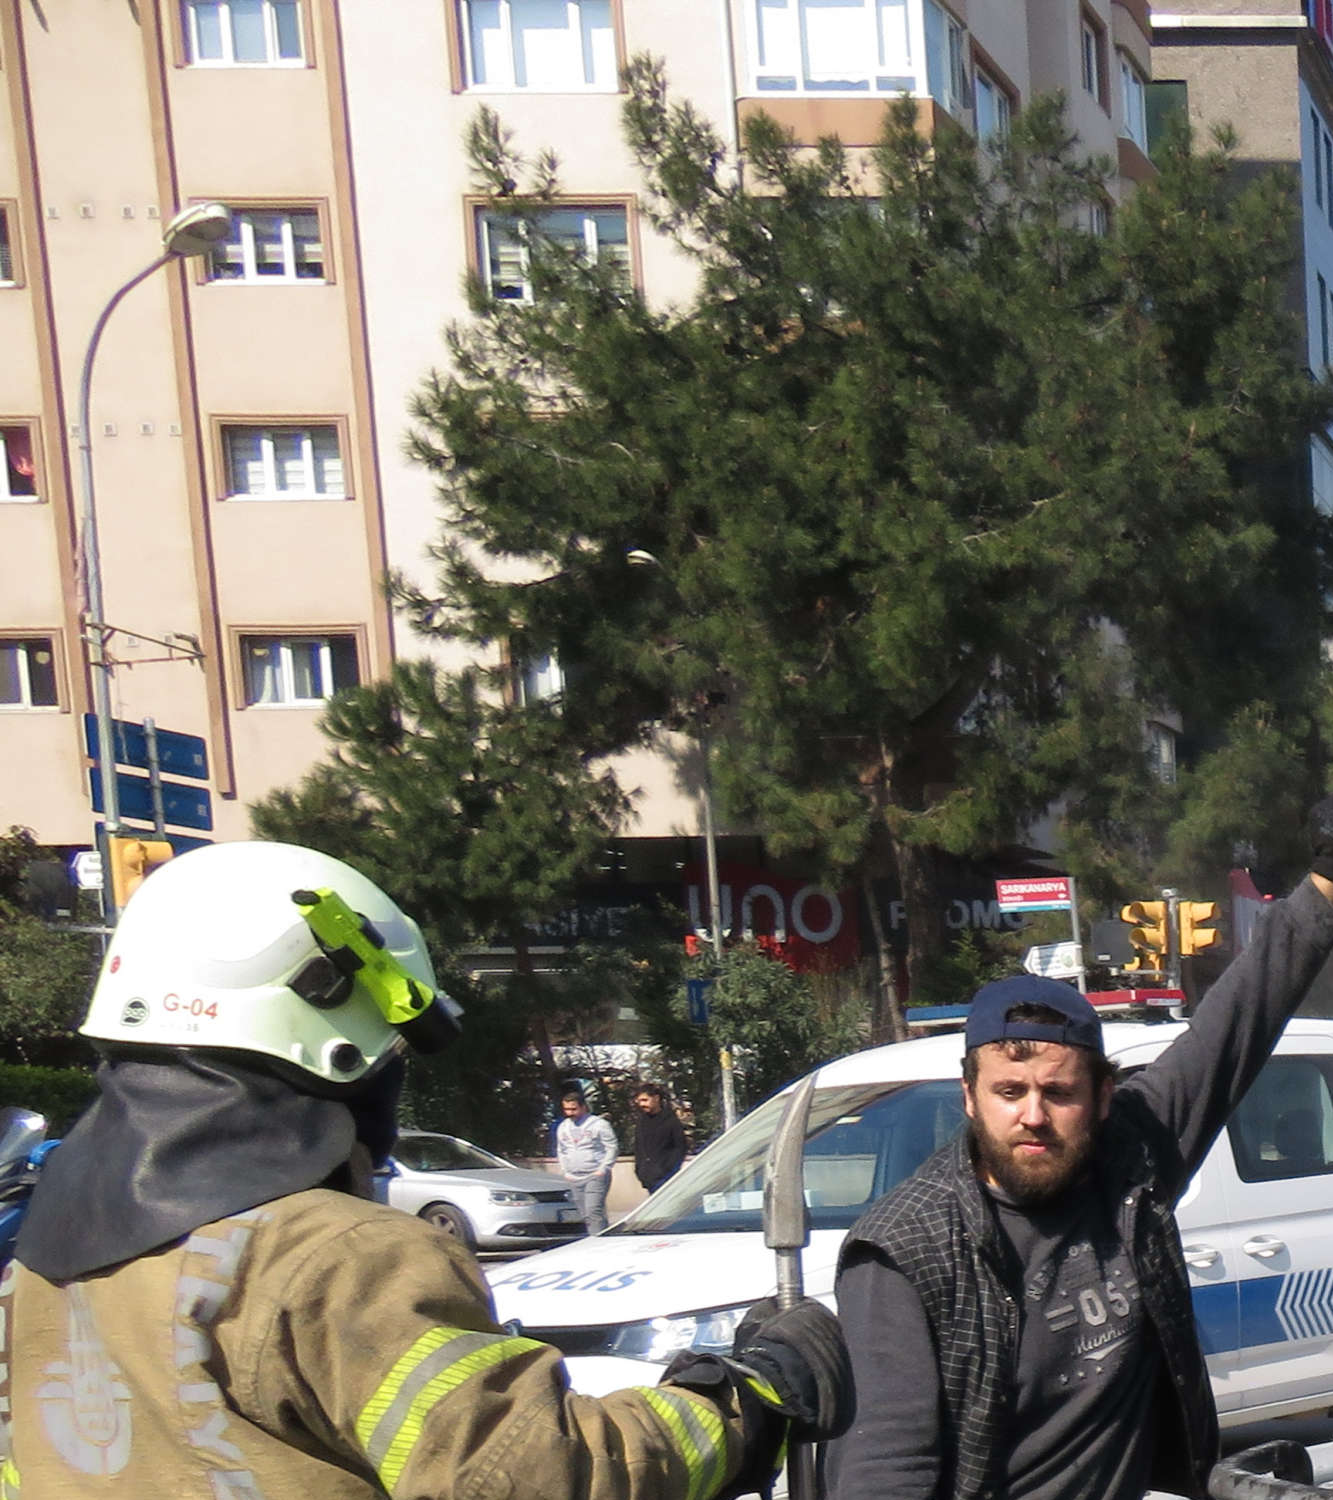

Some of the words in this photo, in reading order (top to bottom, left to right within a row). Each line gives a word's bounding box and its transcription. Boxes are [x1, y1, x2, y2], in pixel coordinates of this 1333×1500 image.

[688, 884, 843, 943] uno
[163, 993, 218, 1019] G-04
[492, 1265, 653, 1292] POLİS
